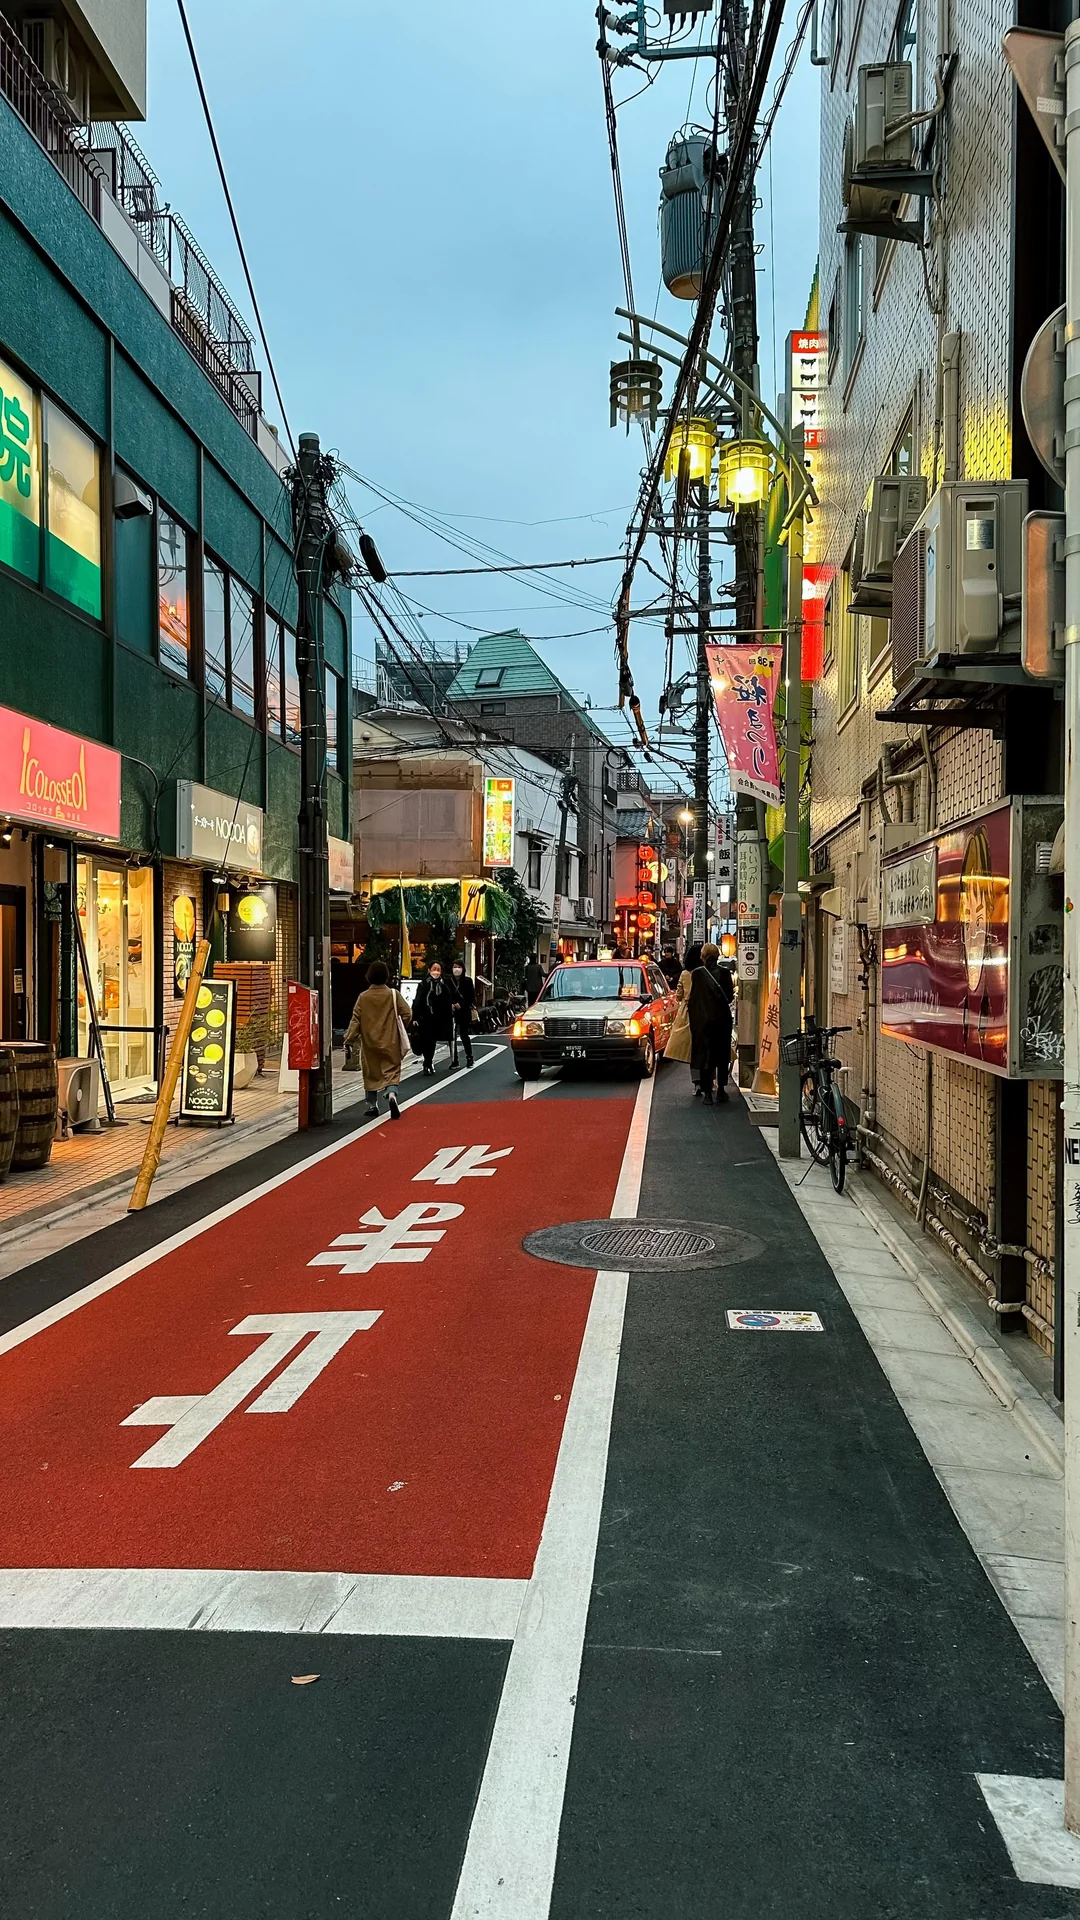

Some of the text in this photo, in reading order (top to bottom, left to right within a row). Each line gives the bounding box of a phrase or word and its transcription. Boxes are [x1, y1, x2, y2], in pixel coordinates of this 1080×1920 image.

[798, 338, 818, 349] 焼肉
[215, 816, 246, 845] NOCOA
[748, 845, 758, 885] いいづか
[760, 989, 780, 1058] 業中
